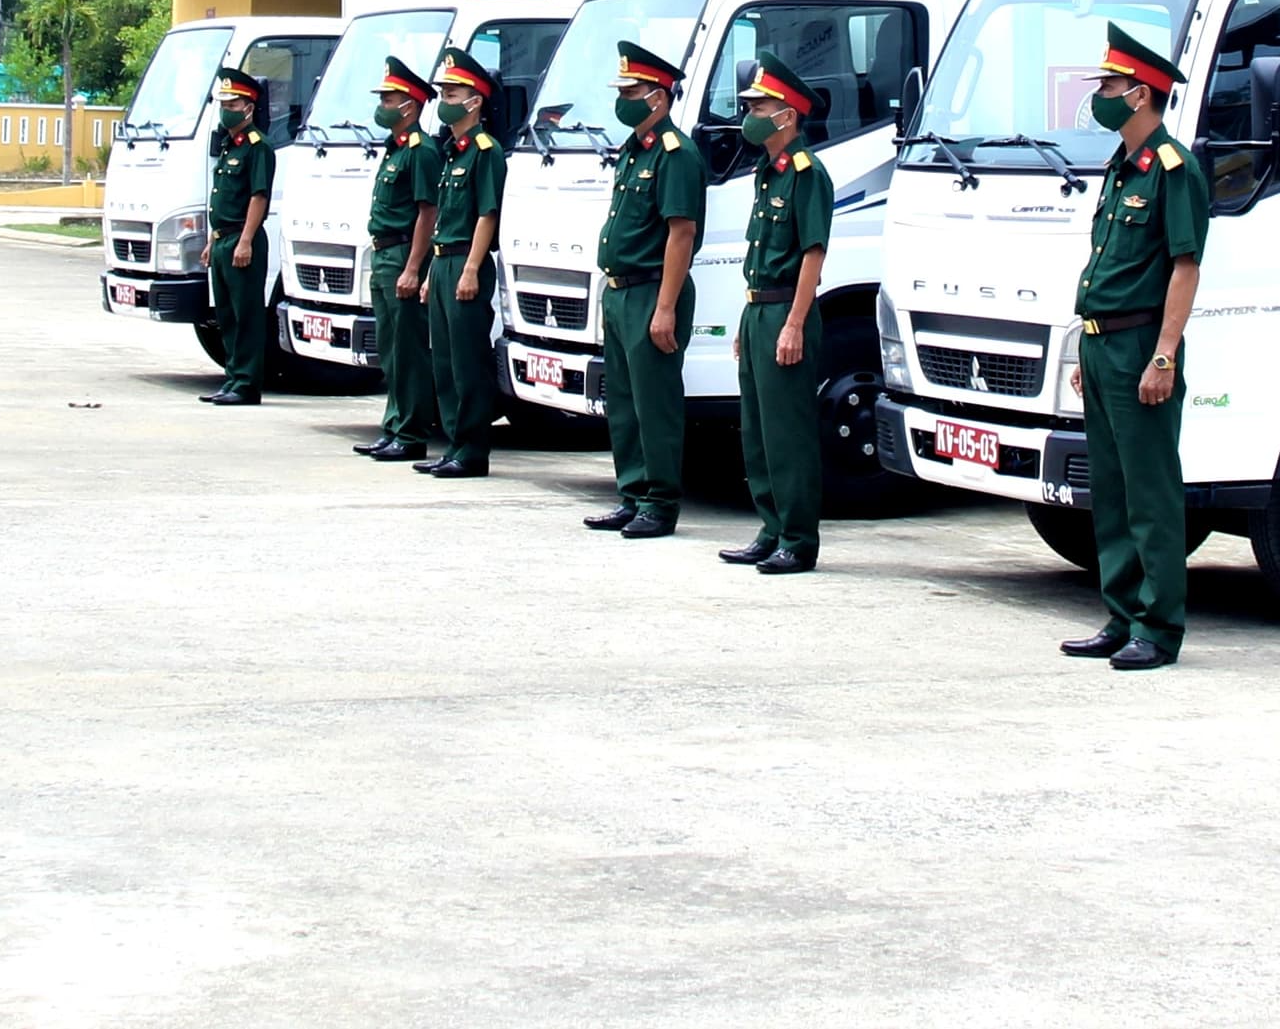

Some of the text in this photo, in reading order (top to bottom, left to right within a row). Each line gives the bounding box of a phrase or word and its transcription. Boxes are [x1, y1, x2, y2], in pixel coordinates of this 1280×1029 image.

[513, 238, 583, 254] FUSO
[913, 279, 1038, 302] FUSO
[936, 422, 998, 464] KV-05-03
[1043, 482, 1074, 505] 12-04
